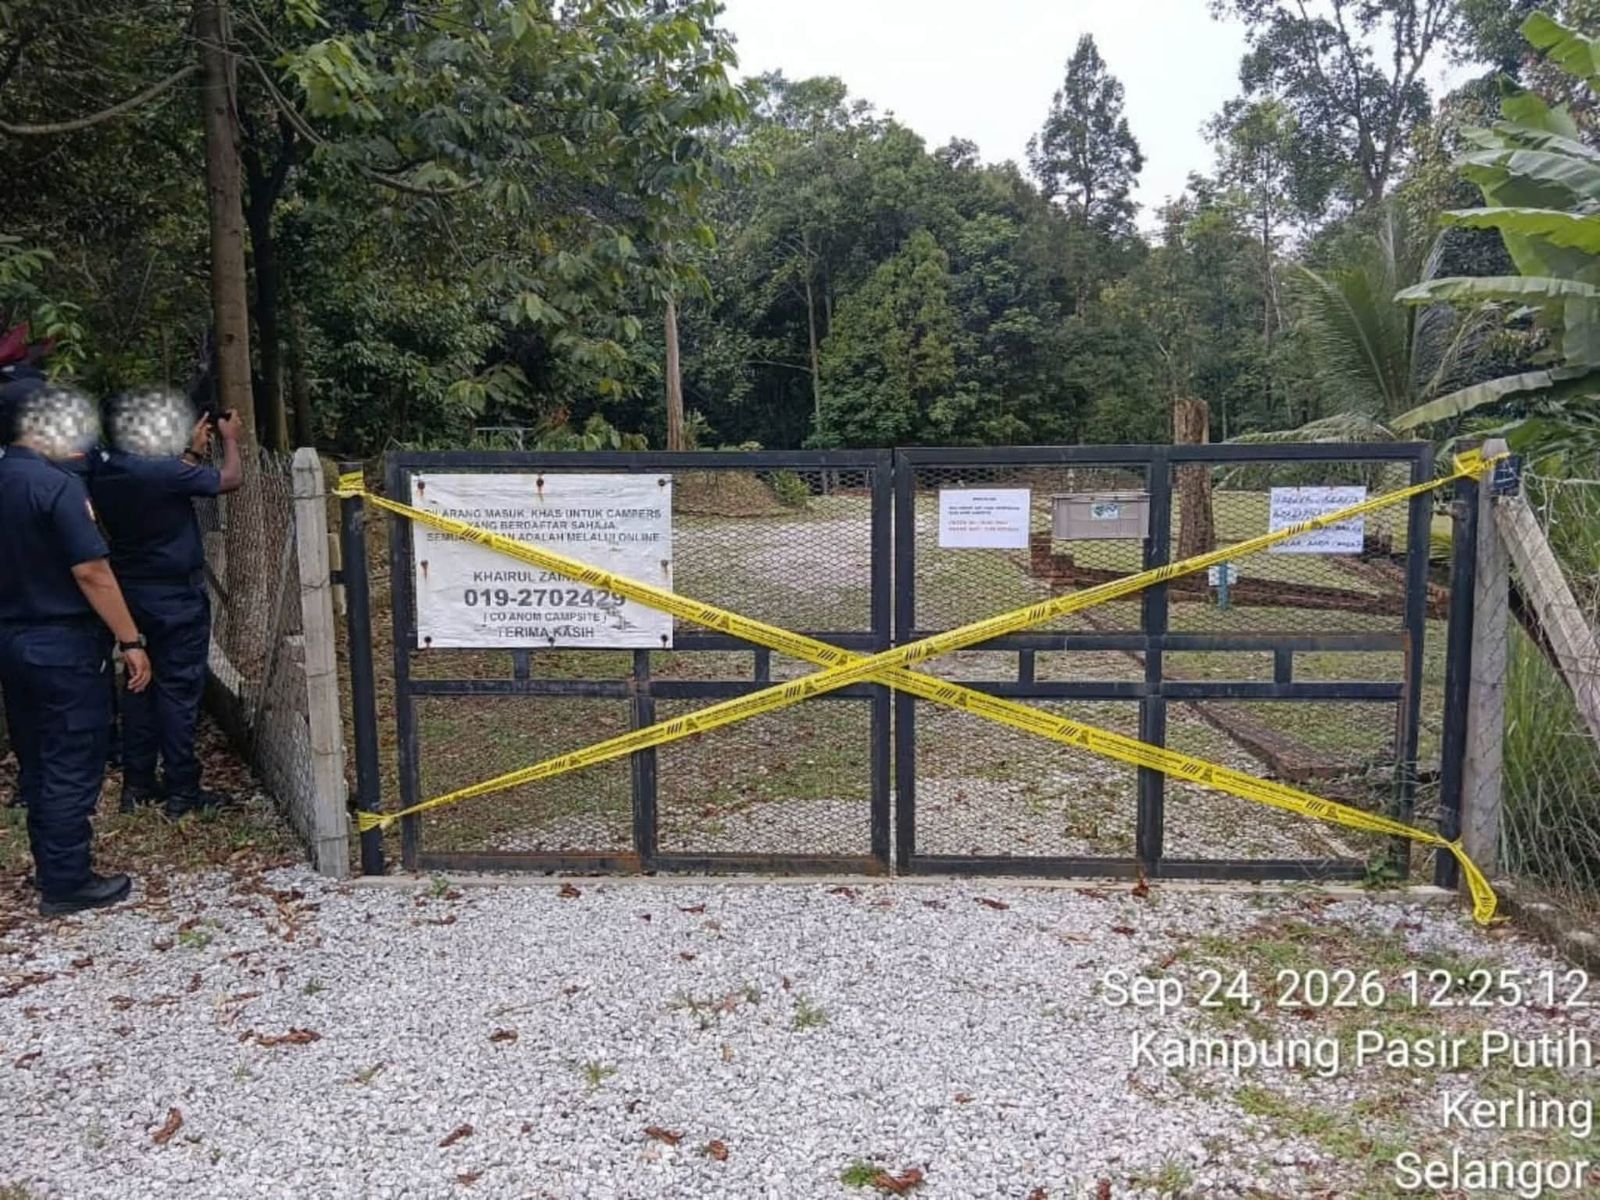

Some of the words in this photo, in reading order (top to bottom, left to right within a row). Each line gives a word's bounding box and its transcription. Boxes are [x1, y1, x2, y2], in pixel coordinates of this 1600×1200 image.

[531, 508, 562, 519] KHAS
[565, 508, 603, 519] UNTUK
[606, 508, 662, 519] CAMPERS
[500, 520, 568, 530] BERDAFTAR
[518, 532, 564, 542] ADALAH
[566, 532, 616, 542] MELALUI
[618, 532, 660, 542] ONLINE
[473, 571, 536, 582] KHAIRUL
[464, 588, 626, 607] 019-2702429
[508, 612, 542, 622] ANOM
[544, 612, 601, 622] CAMPSITE
[498, 626, 549, 638] TERIMA
[553, 626, 594, 638] KASIH
